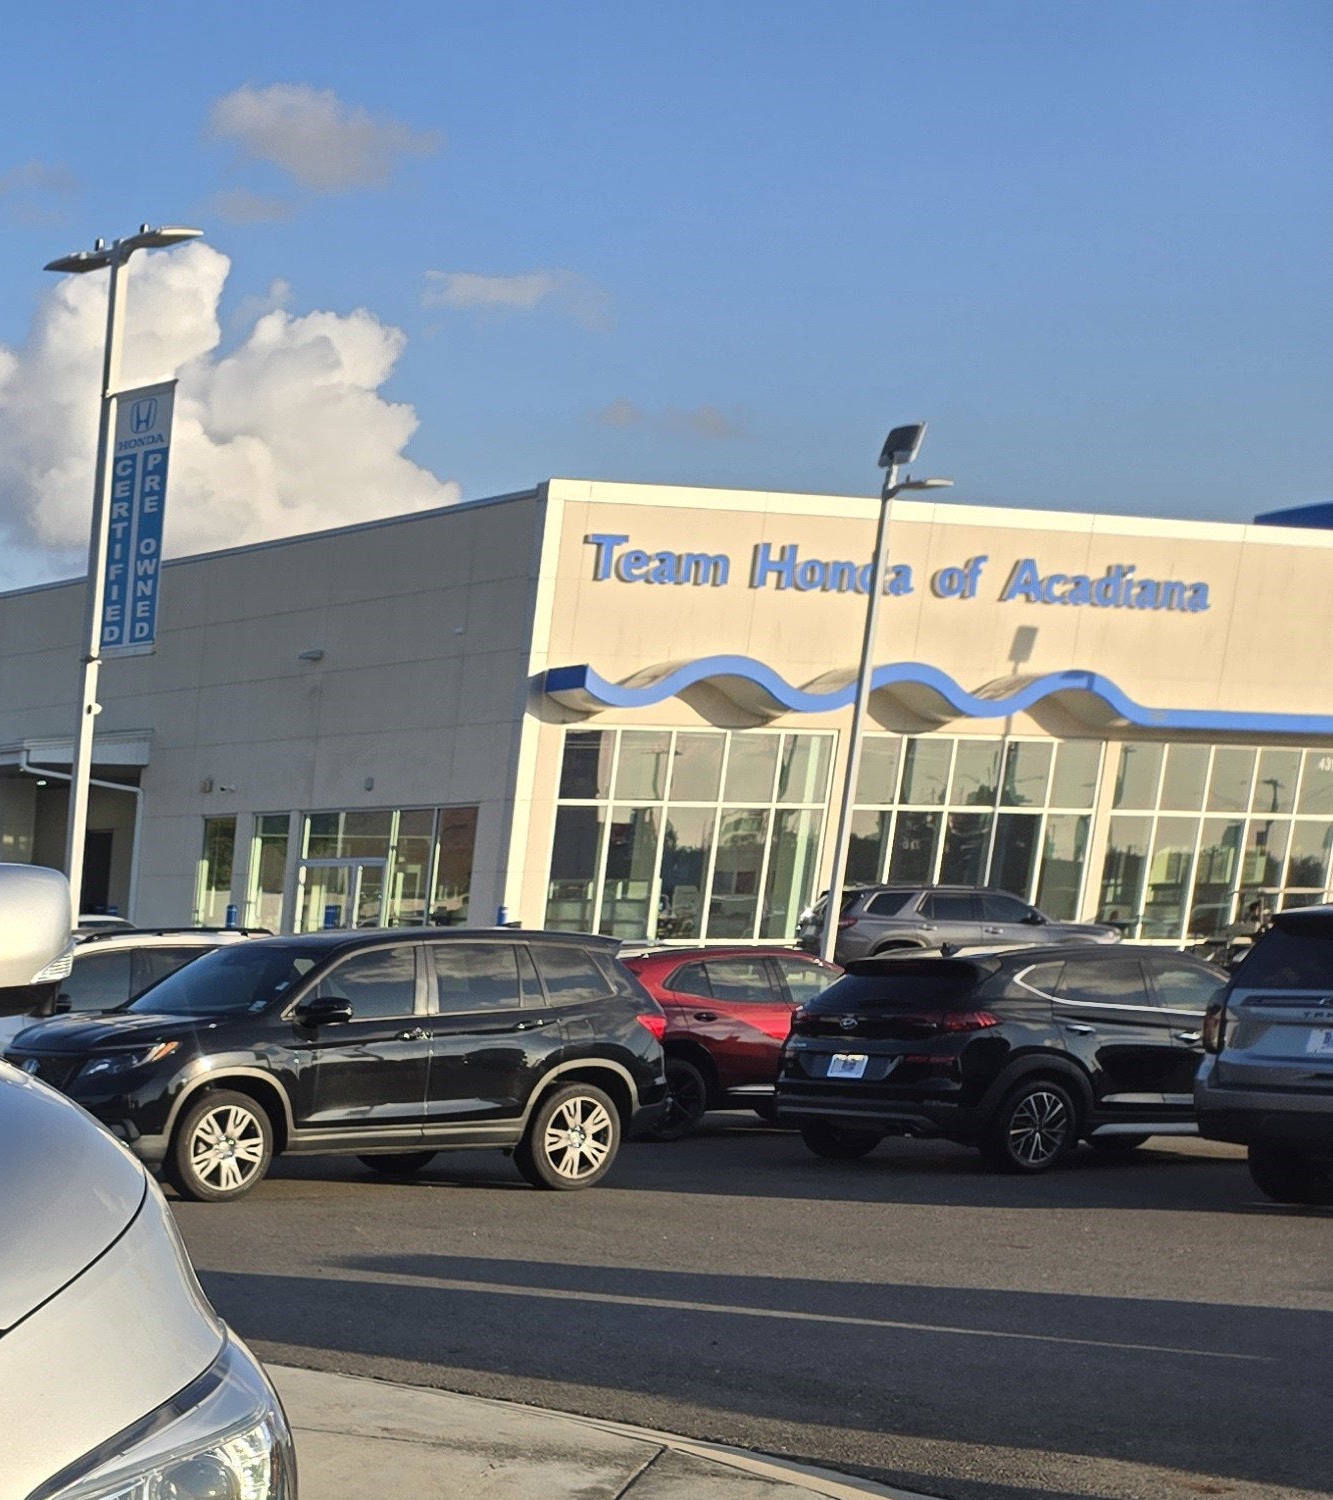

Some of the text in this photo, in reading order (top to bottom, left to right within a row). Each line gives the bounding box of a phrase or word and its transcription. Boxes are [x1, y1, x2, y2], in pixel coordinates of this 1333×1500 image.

[118, 433, 165, 451] HONDA
[103, 459, 133, 642] CERTIFIED
[135, 452, 162, 638] PRE OWNED
[583, 533, 731, 588] Team
[931, 554, 989, 600] of
[997, 558, 1211, 613] Acadiana
